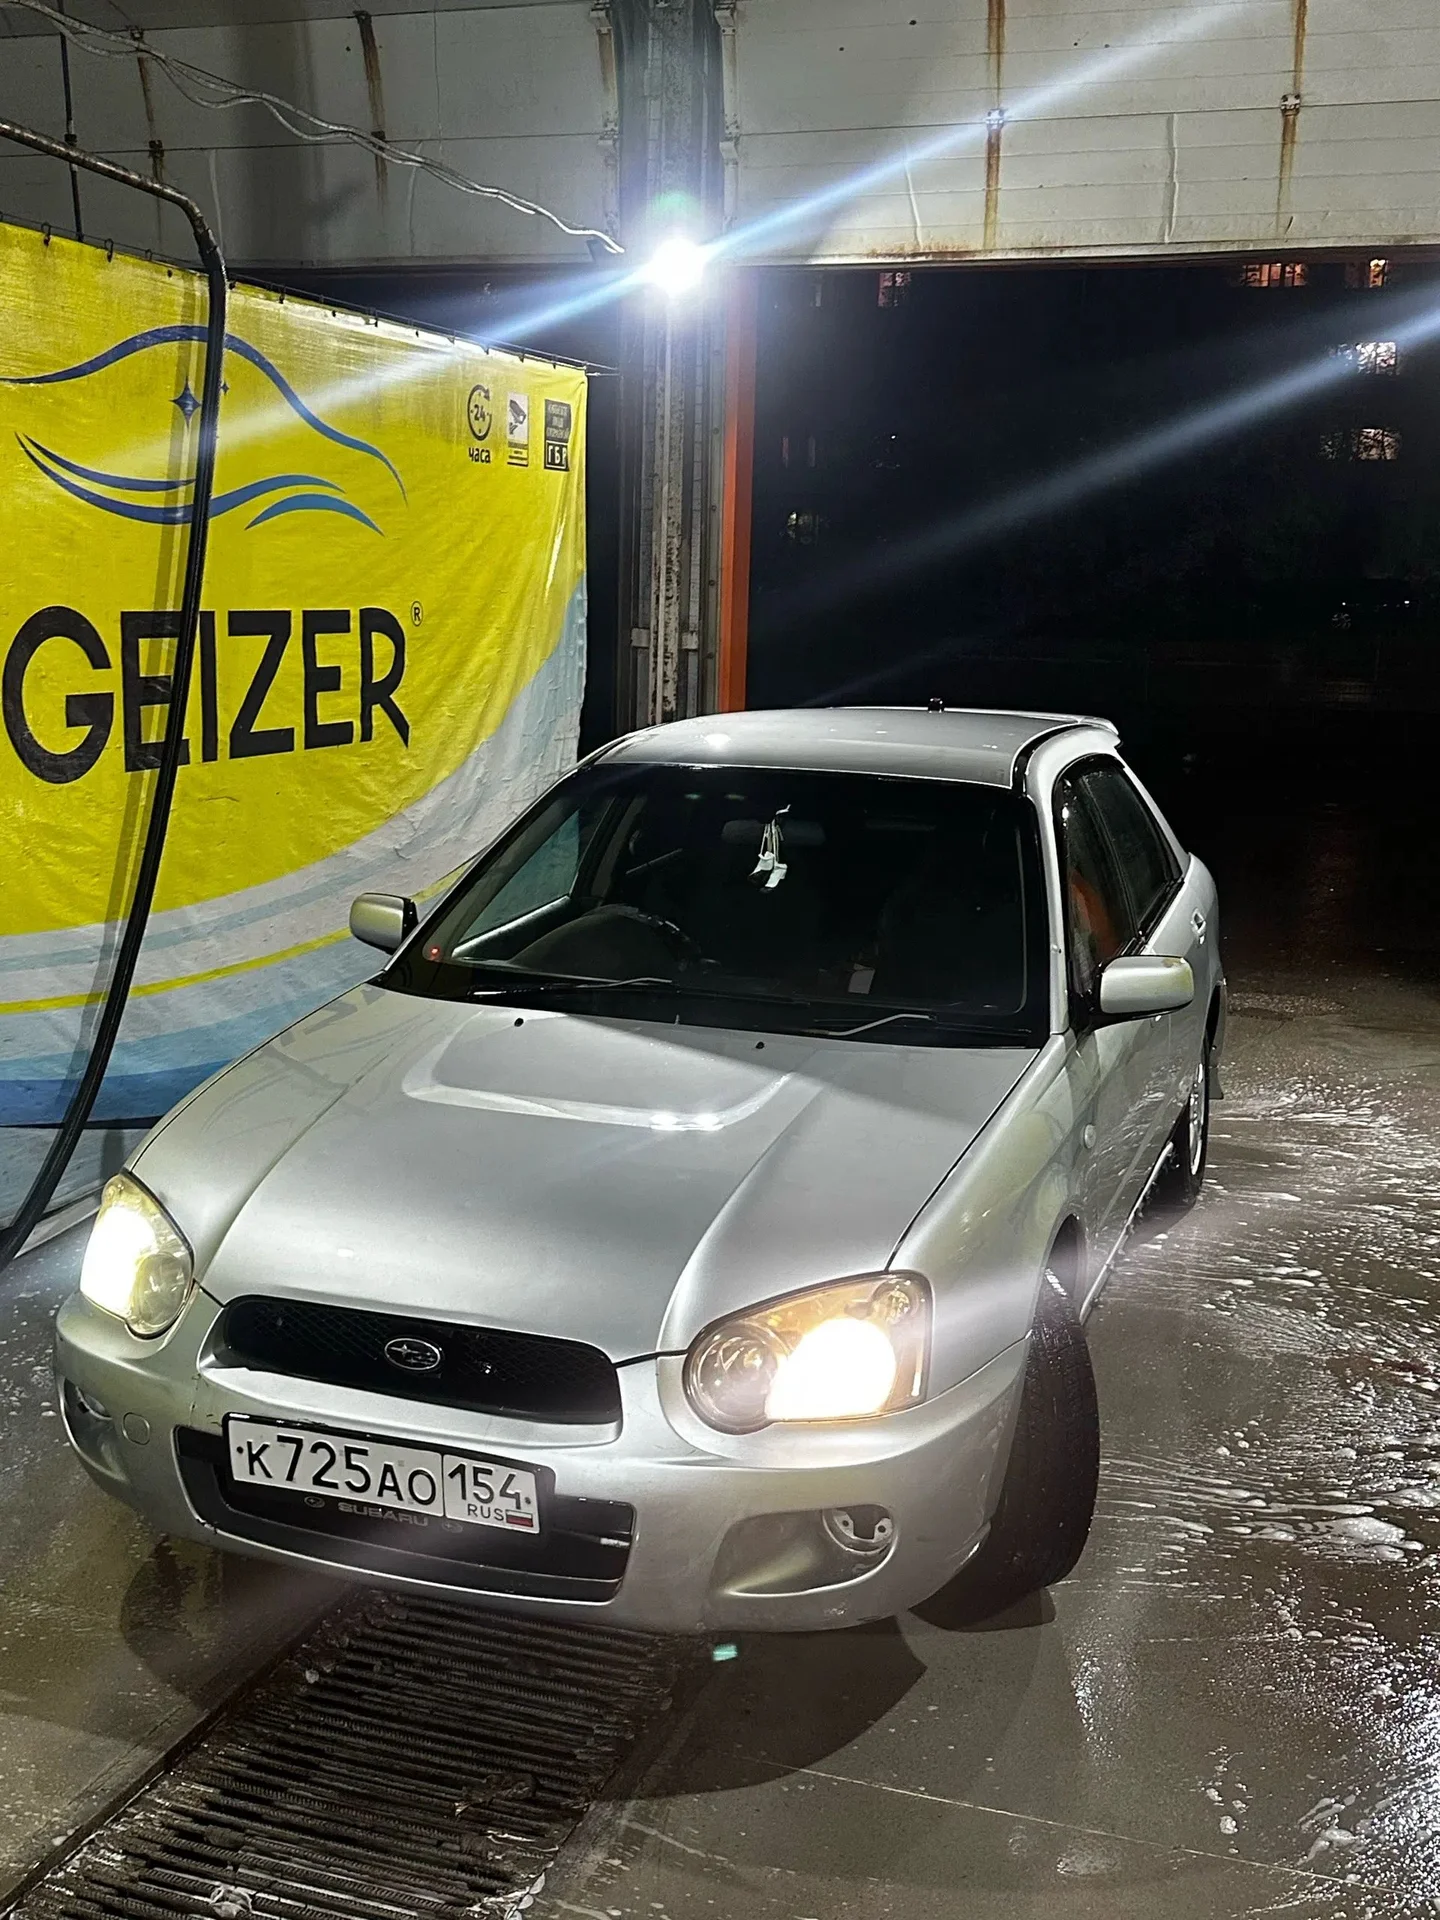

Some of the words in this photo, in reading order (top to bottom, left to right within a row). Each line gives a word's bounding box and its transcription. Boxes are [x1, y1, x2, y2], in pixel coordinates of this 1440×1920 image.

[474, 404, 486, 422] 24
[468, 447, 491, 464] часа
[2, 605, 410, 785] GEIZER
[447, 1463, 522, 1510] 154
[338, 1502, 429, 1527] SUBARU
[467, 1503, 505, 1522] RUS
